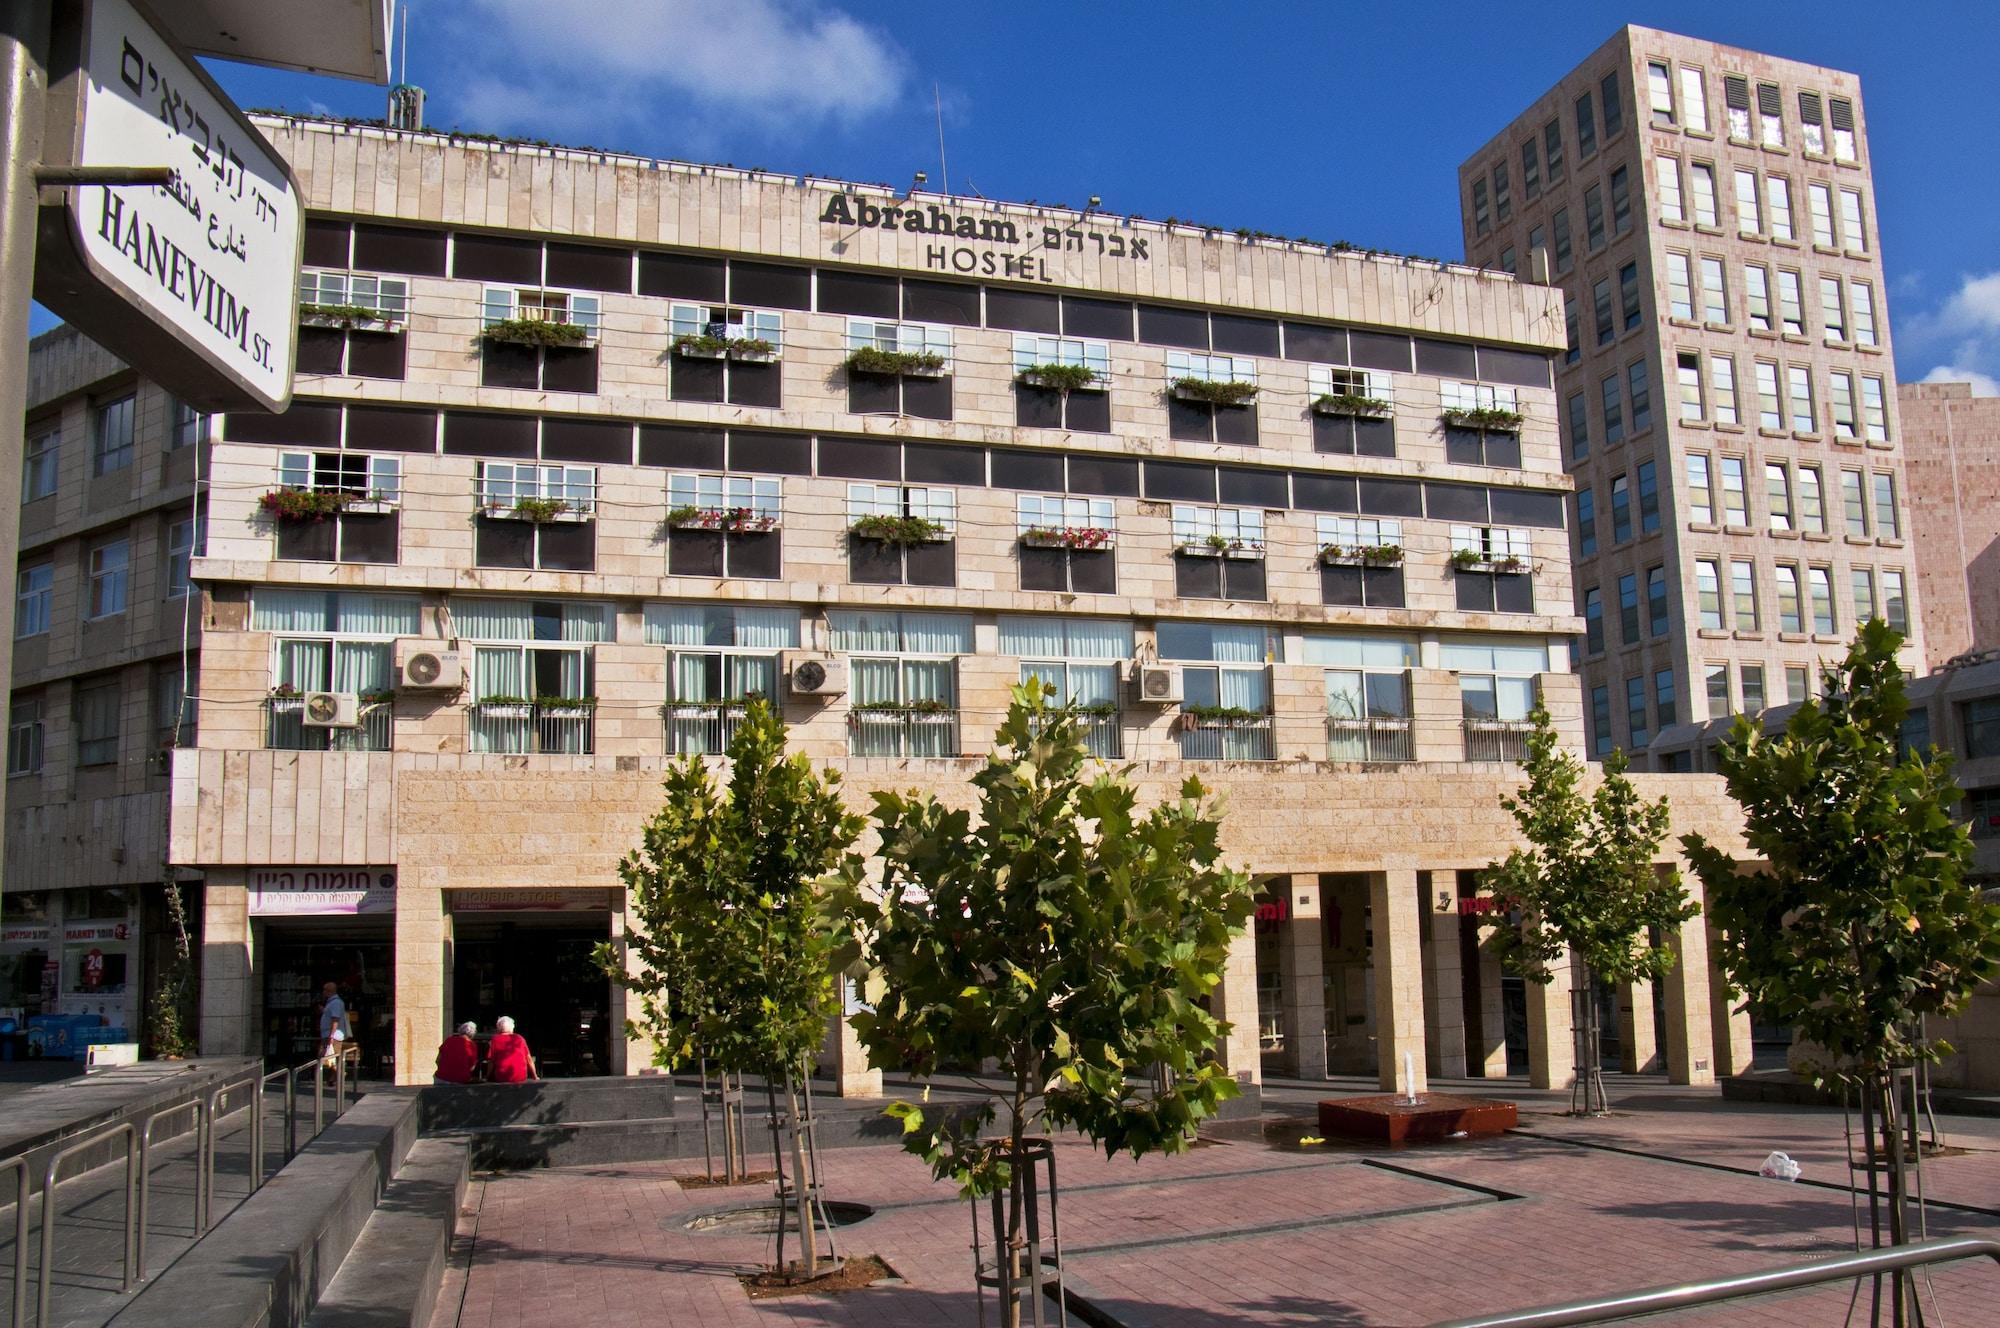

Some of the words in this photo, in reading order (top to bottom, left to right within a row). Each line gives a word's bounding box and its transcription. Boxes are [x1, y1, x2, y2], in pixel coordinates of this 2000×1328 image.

[818, 194, 1020, 244] Abraham
[207, 215, 246, 263] شارع
[1042, 225, 1150, 261] אברהם
[98, 186, 250, 354] HANEVIIM
[253, 332, 274, 374] ST.
[926, 244, 1054, 283] HOSTEL
[256, 873, 295, 909] היין
[302, 871, 371, 892] חומות
[519, 891, 562, 903] STORE
[87, 954, 103, 970] 24
